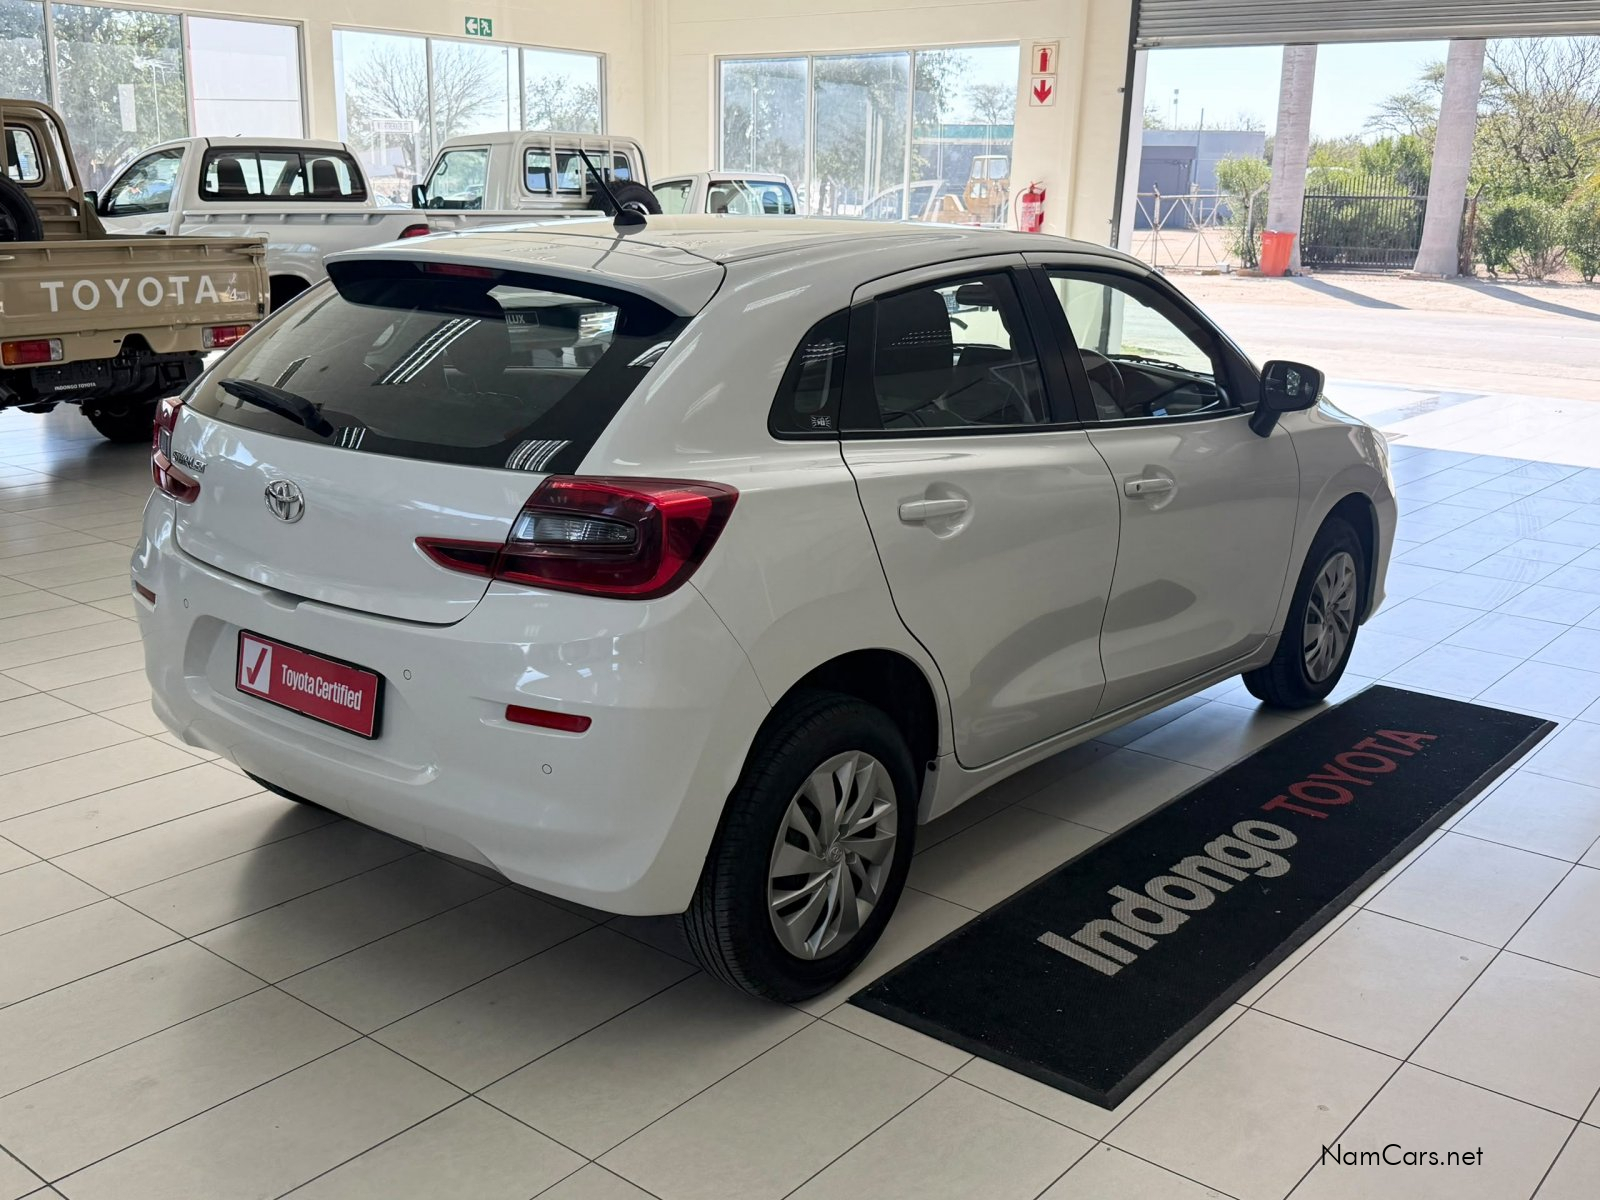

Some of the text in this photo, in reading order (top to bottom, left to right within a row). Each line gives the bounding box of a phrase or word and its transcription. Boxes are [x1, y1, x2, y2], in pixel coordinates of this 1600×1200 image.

[40, 275, 220, 312] TOYOTA
[505, 314, 526, 325] ILUX
[282, 664, 363, 711] Toyota Certified
[1037, 728, 1438, 976] Indongo TOYOTA
